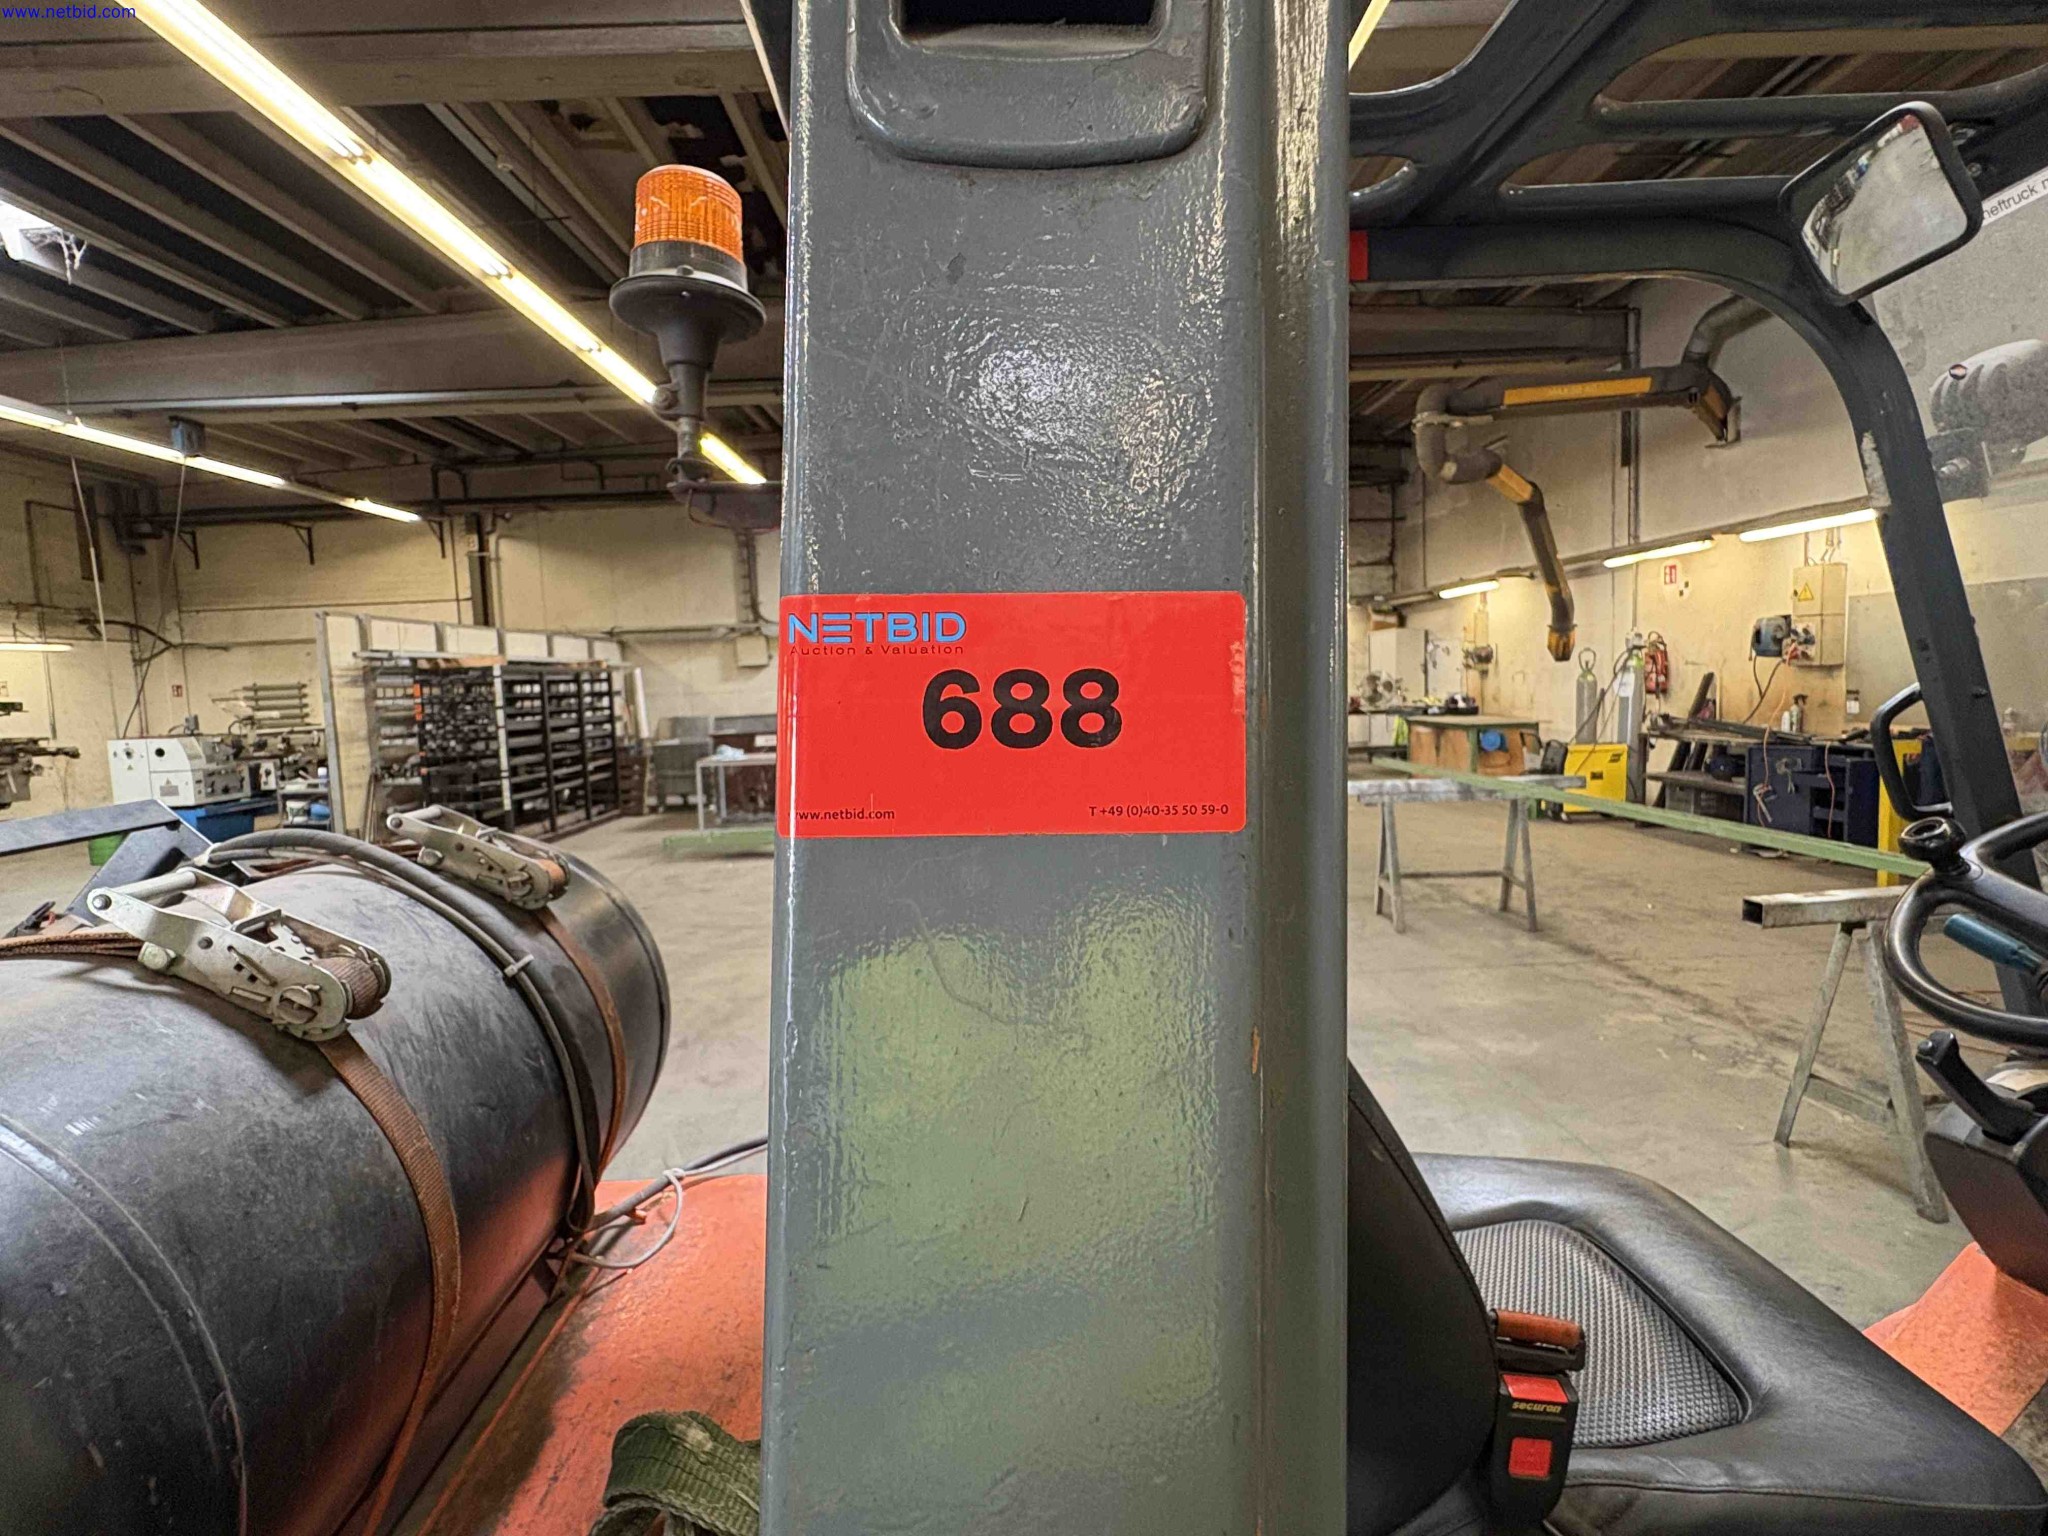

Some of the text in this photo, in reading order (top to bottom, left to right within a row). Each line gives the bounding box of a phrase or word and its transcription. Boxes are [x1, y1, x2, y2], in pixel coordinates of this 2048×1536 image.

[788, 612, 967, 644] NETBID
[790, 645, 964, 656] Auction & Valuation
[922, 668, 1123, 750] 688
[1089, 804, 1229, 817] T +49 (0)40-35 50 59-0
[1512, 1401, 1562, 1413] securon
